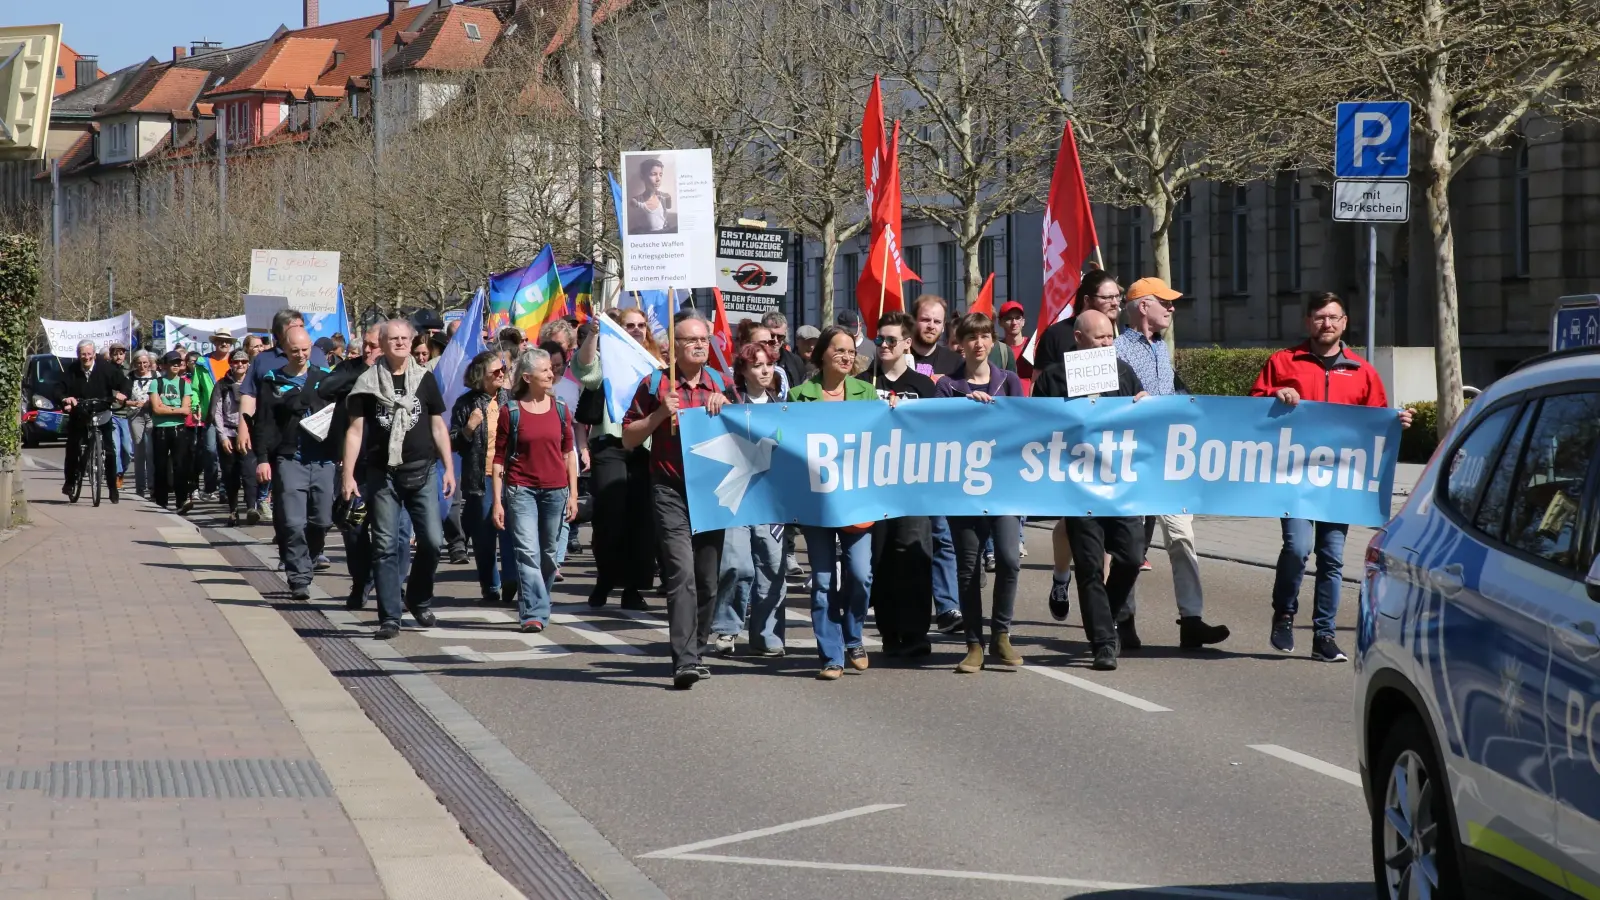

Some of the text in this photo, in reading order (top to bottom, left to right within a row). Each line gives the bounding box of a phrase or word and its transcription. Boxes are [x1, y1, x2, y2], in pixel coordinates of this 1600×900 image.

[1353, 112, 1392, 167] P
[1362, 190, 1381, 200] mit
[1340, 202, 1402, 213] Parkschein
[721, 230, 784, 244] ERST PANZER,
[630, 240, 684, 249] Deutsche Waffen
[720, 239, 784, 252] DANN FLUGZEUGE,
[255, 250, 278, 266] Ein
[638, 252, 685, 261] Kriegsgebieten
[719, 247, 783, 259] DANN UNSERE SOLDATEN!
[266, 267, 318, 286] Europa
[639, 274, 660, 282] einem
[660, 273, 687, 281] Frieden!
[723, 293, 731, 303] ÜR
[731, 294, 746, 303] DEN
[746, 295, 776, 305] FRIEDEN
[723, 302, 735, 310] GEN
[735, 303, 745, 311] DIE
[1066, 349, 1115, 362] DIPLOMATIE
[1067, 362, 1116, 379] FRIEDEN
[806, 423, 1386, 496] Bildung statt Bomben!
